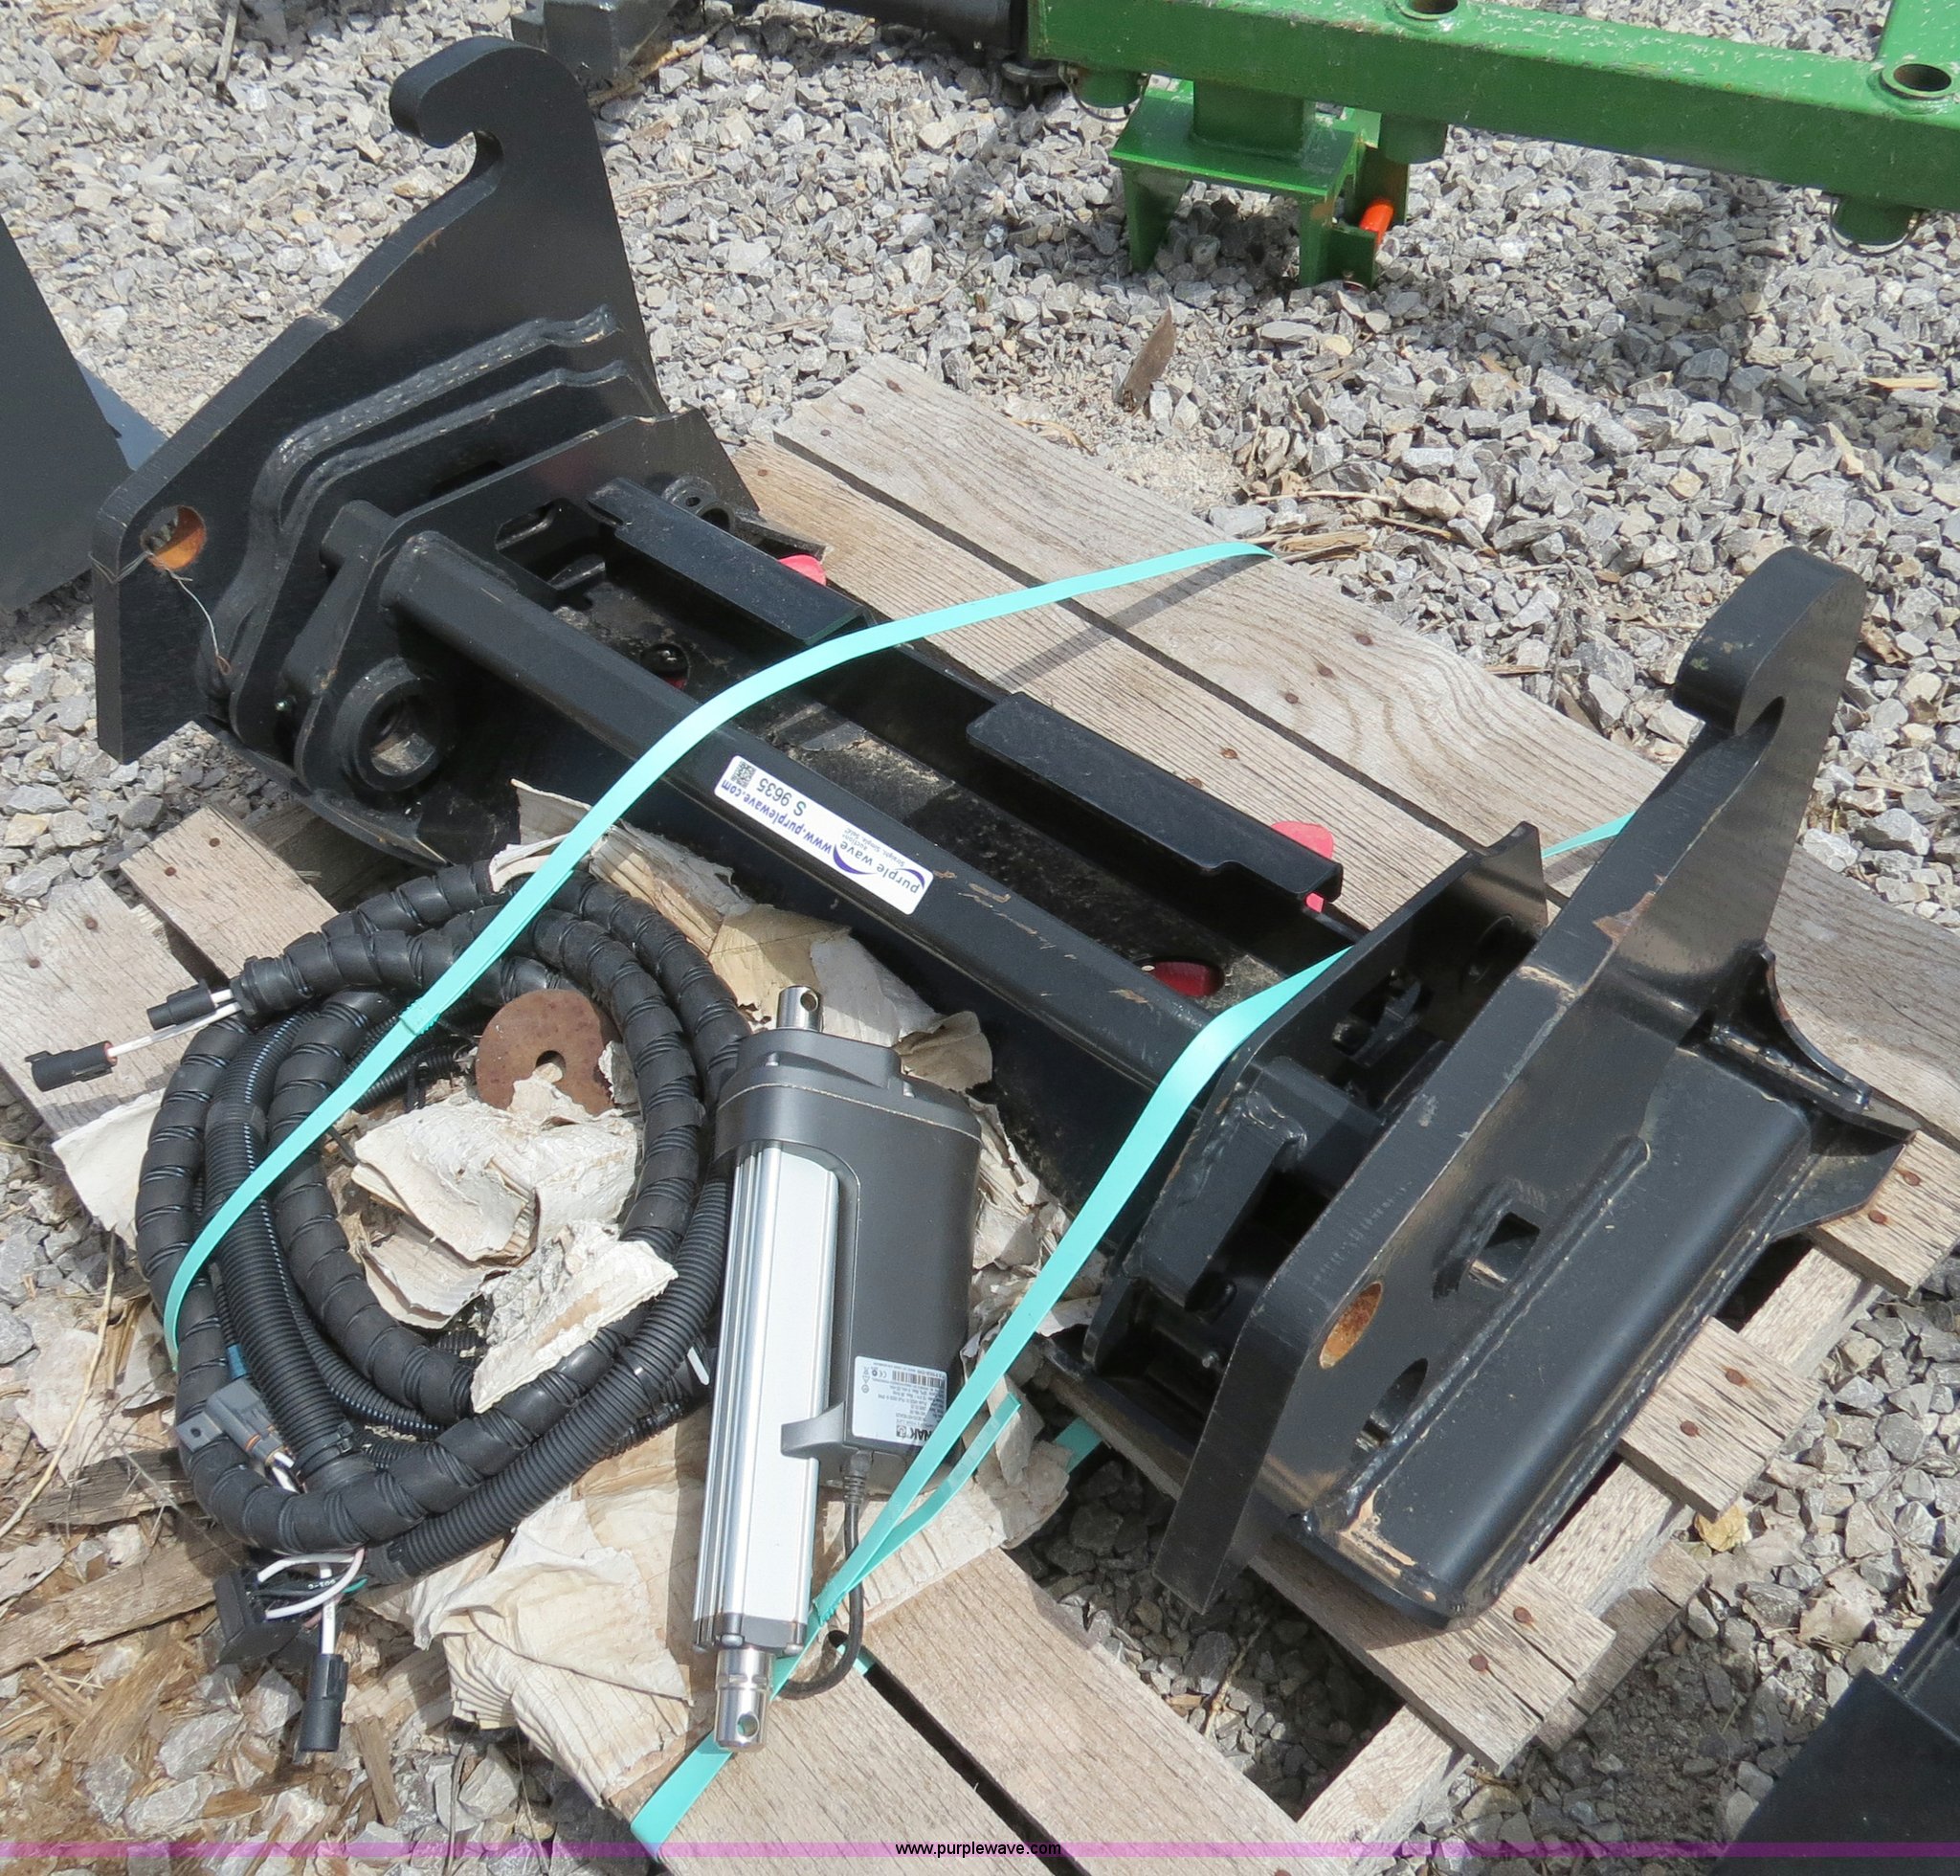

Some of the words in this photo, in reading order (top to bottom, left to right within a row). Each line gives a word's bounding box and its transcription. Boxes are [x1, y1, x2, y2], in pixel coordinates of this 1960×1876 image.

[756, 777, 792, 806] 9635
[722, 779, 833, 854] www.purplewave.com
[793, 800, 807, 816] S
[839, 840, 873, 866] wave
[877, 862, 921, 893] purple
[910, 1427, 933, 1441] NAK
